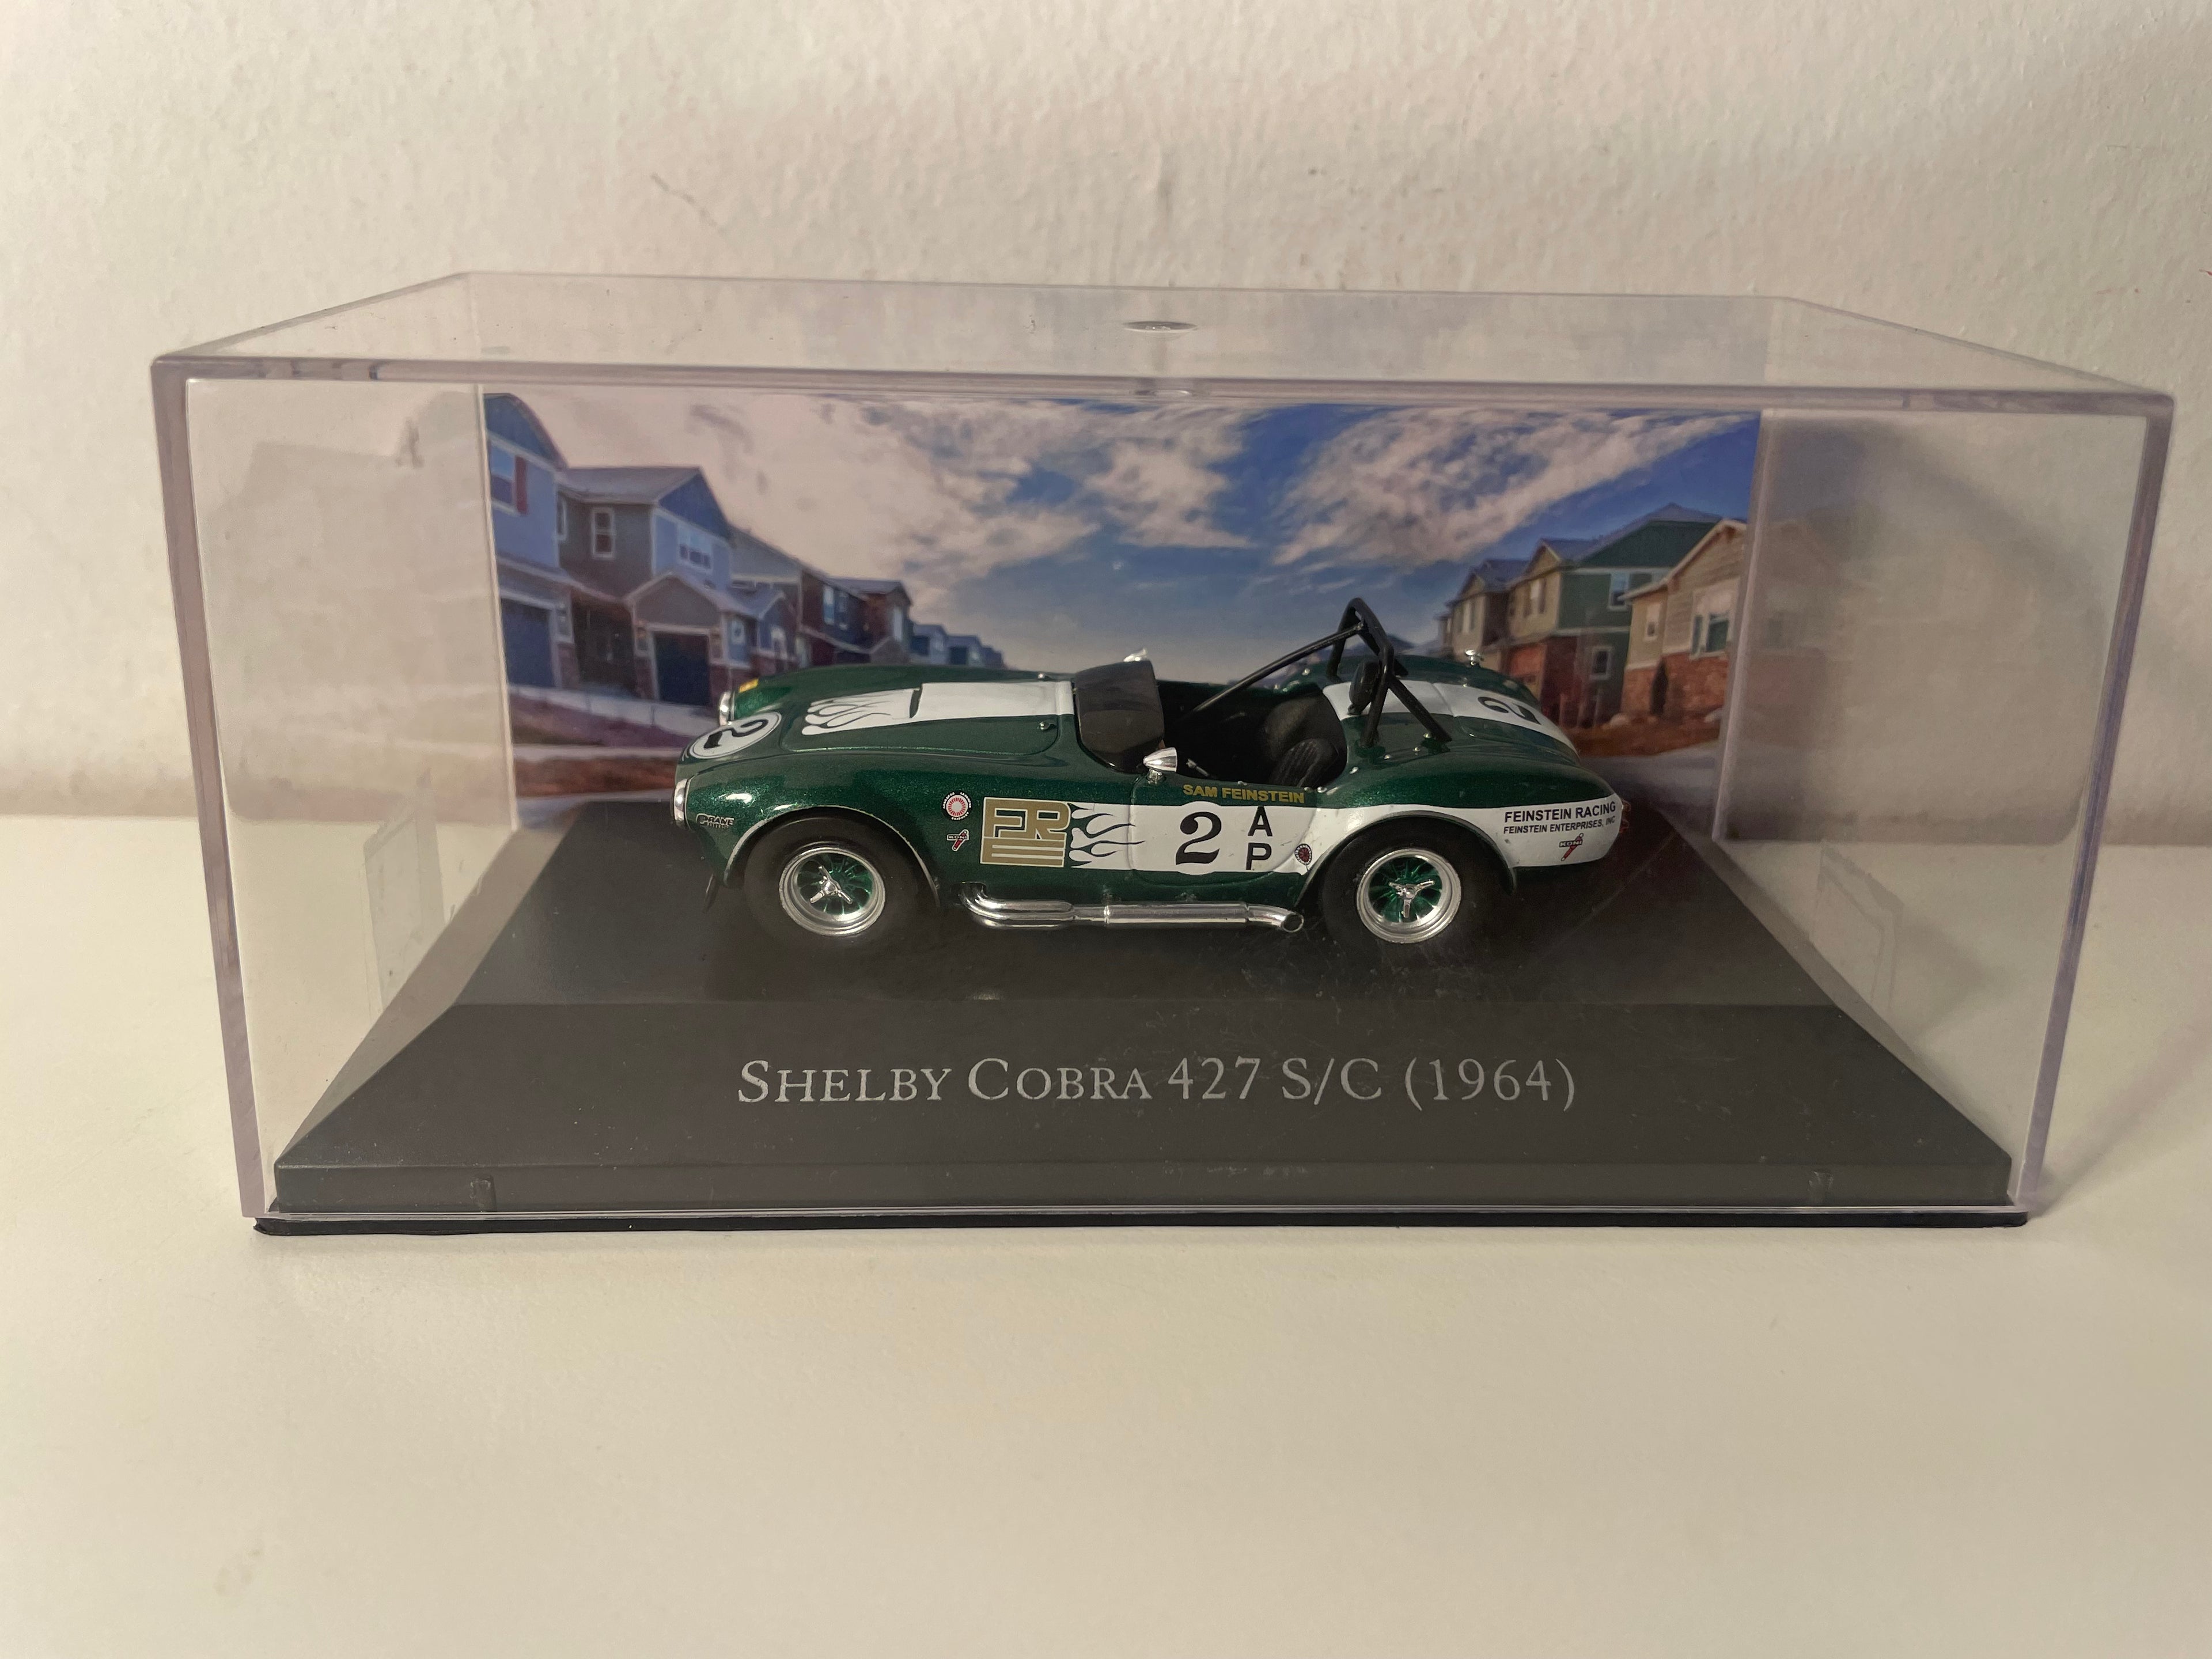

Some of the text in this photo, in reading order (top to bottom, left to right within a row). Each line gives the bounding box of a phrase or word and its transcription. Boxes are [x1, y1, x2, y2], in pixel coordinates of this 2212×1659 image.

[1183, 784, 1305, 804] SAM FEINSTEIN
[1247, 805, 1273, 837] A
[1504, 801, 1616, 823] FEINSTEIN RACING
[1175, 811, 1222, 866] 2
[1503, 823, 1548, 834] FEINSTEIN
[1245, 842, 1272, 871] P
[737, 1055, 1575, 1112] SHELBY COBRA 427 S/C (1964)
